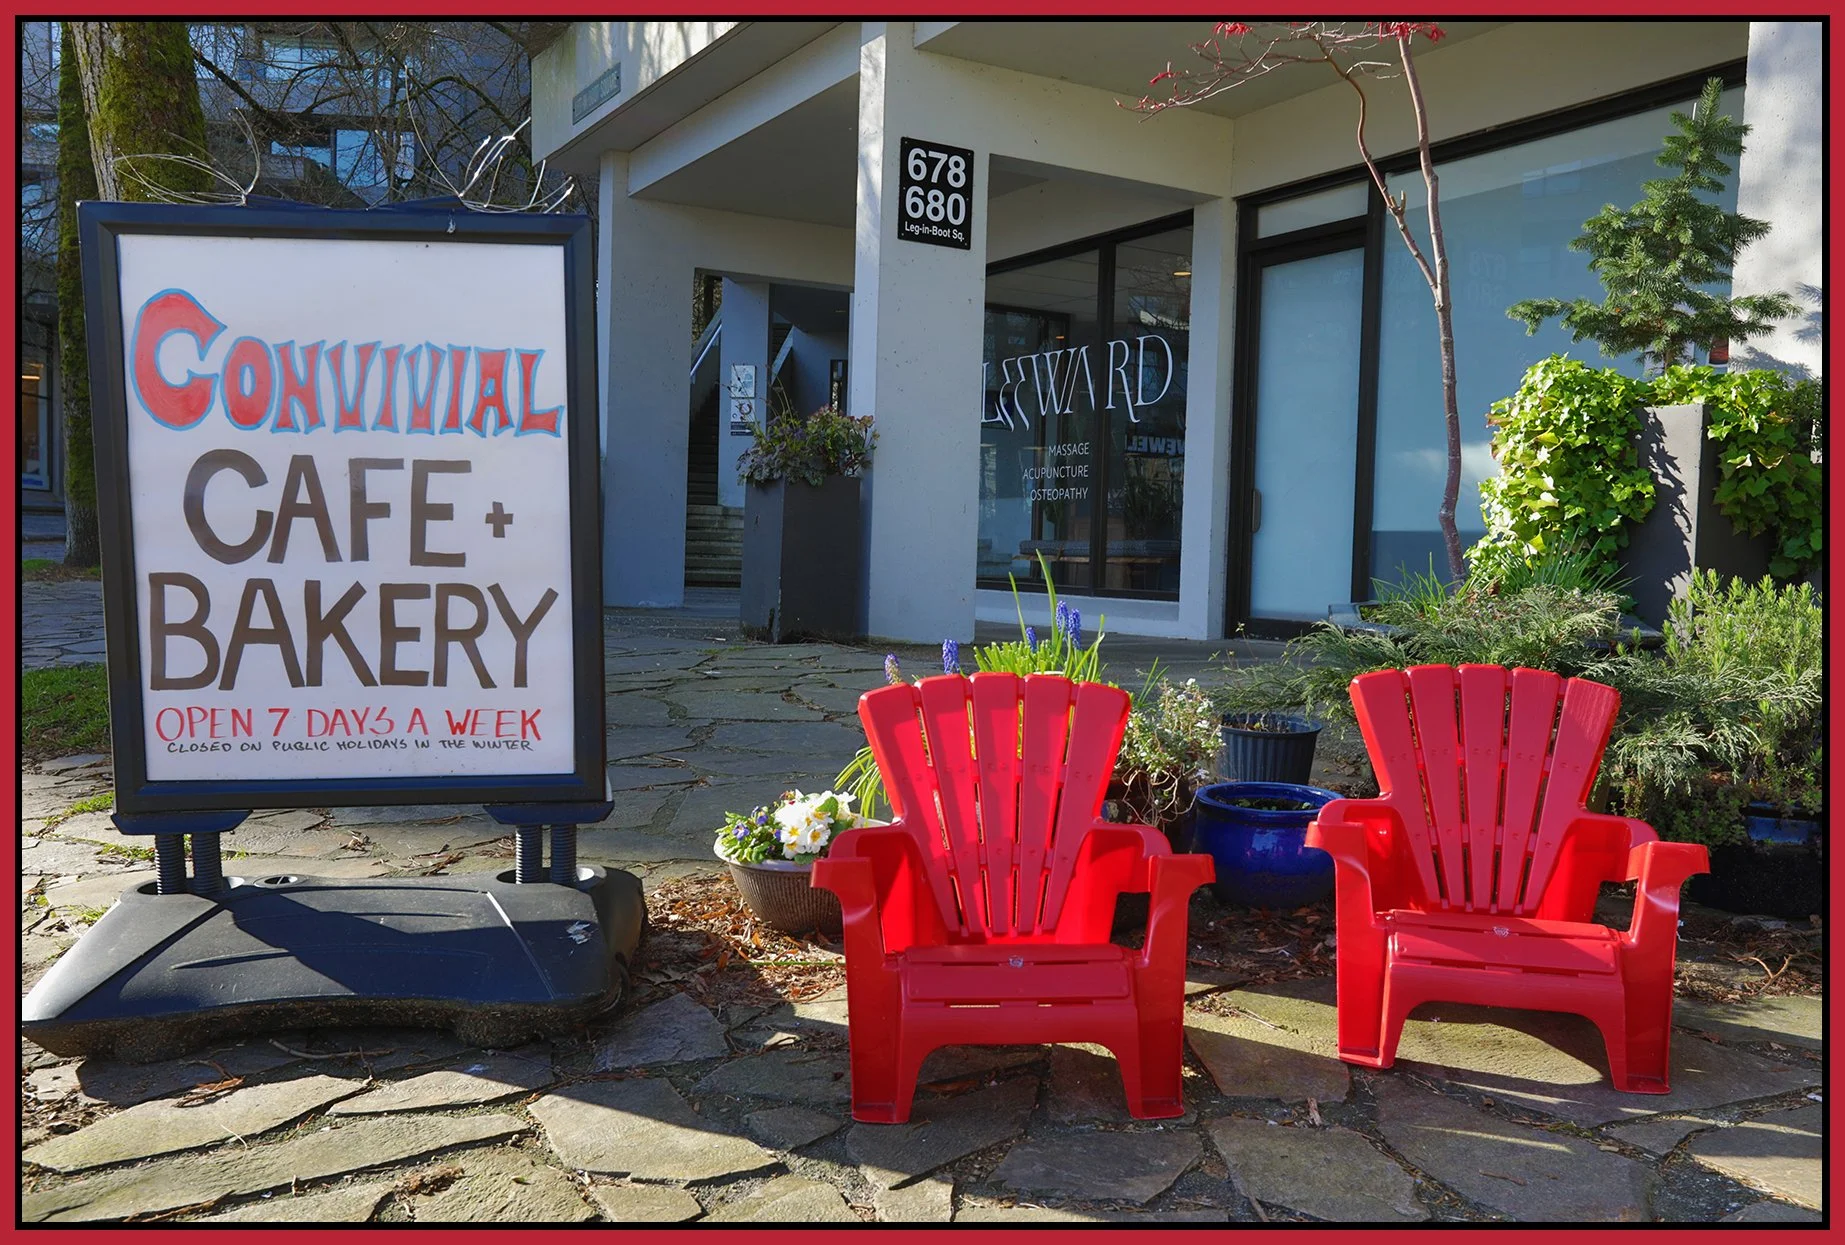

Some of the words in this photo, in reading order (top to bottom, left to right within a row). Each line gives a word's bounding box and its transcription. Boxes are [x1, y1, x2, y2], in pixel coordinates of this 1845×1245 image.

[907, 147, 967, 188] 678
[905, 185, 966, 226] 680
[904, 220, 951, 239] Leg-in-Boot
[952, 229, 965, 242] Sq.
[1048, 442, 1090, 457] MASSAGE
[1022, 464, 1089, 480] ACUPUNCTURE
[183, 448, 472, 567] CAFE
[485, 501, 514, 538] +
[1030, 487, 1089, 502] OSTEOPATHY
[148, 572, 559, 691] BAKERY
[155, 706, 253, 742] OPEN
[267, 708, 290, 737] 7
[307, 706, 395, 738] DAYS
[407, 707, 429, 736] A
[445, 708, 542, 741] WEEK
[166, 741, 232, 754] CLOSED
[240, 741, 262, 752] ON
[272, 740, 330, 752] PUBLIC
[336, 738, 408, 750] HOLIDAYS
[414, 739, 430, 749] IN
[438, 739, 466, 749] THE
[472, 739, 534, 752] WINTER
